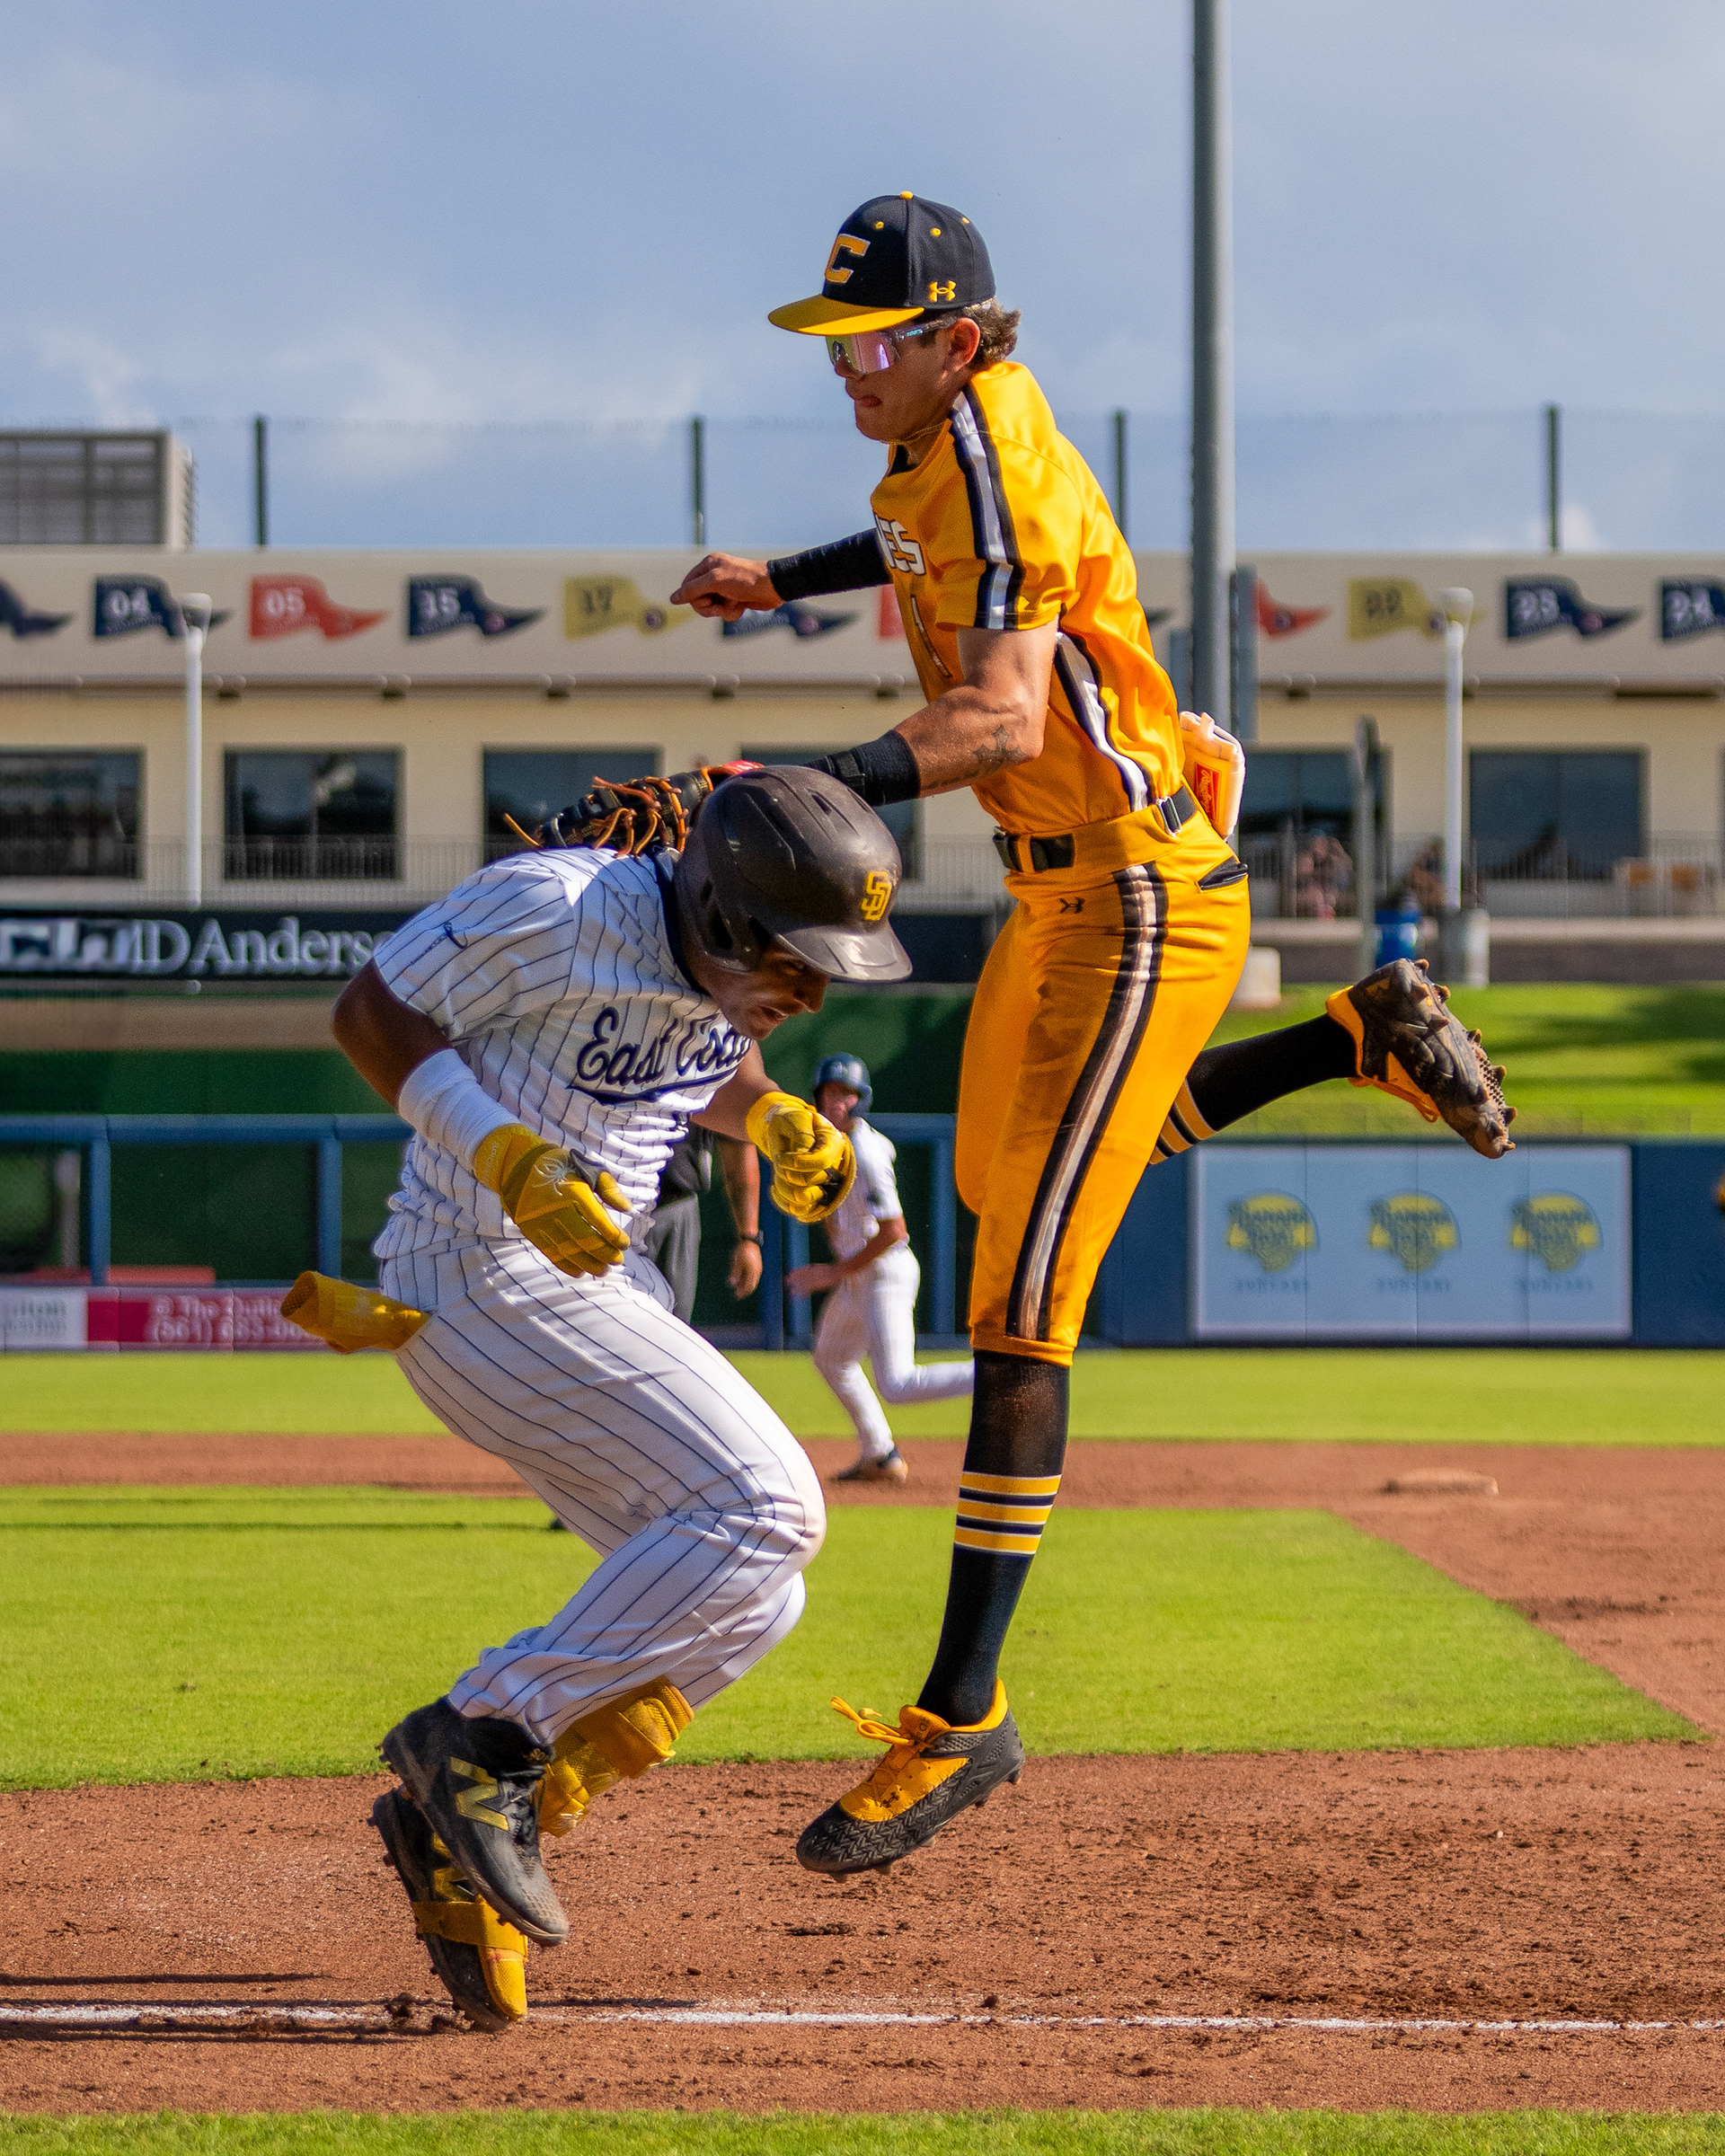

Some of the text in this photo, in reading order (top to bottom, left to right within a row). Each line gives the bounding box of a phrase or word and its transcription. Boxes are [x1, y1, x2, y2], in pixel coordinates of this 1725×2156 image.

[824, 234, 871, 284] C
[265, 587, 305, 619] 05
[860, 870, 892, 921] SD
[577, 1005, 678, 1086] East
